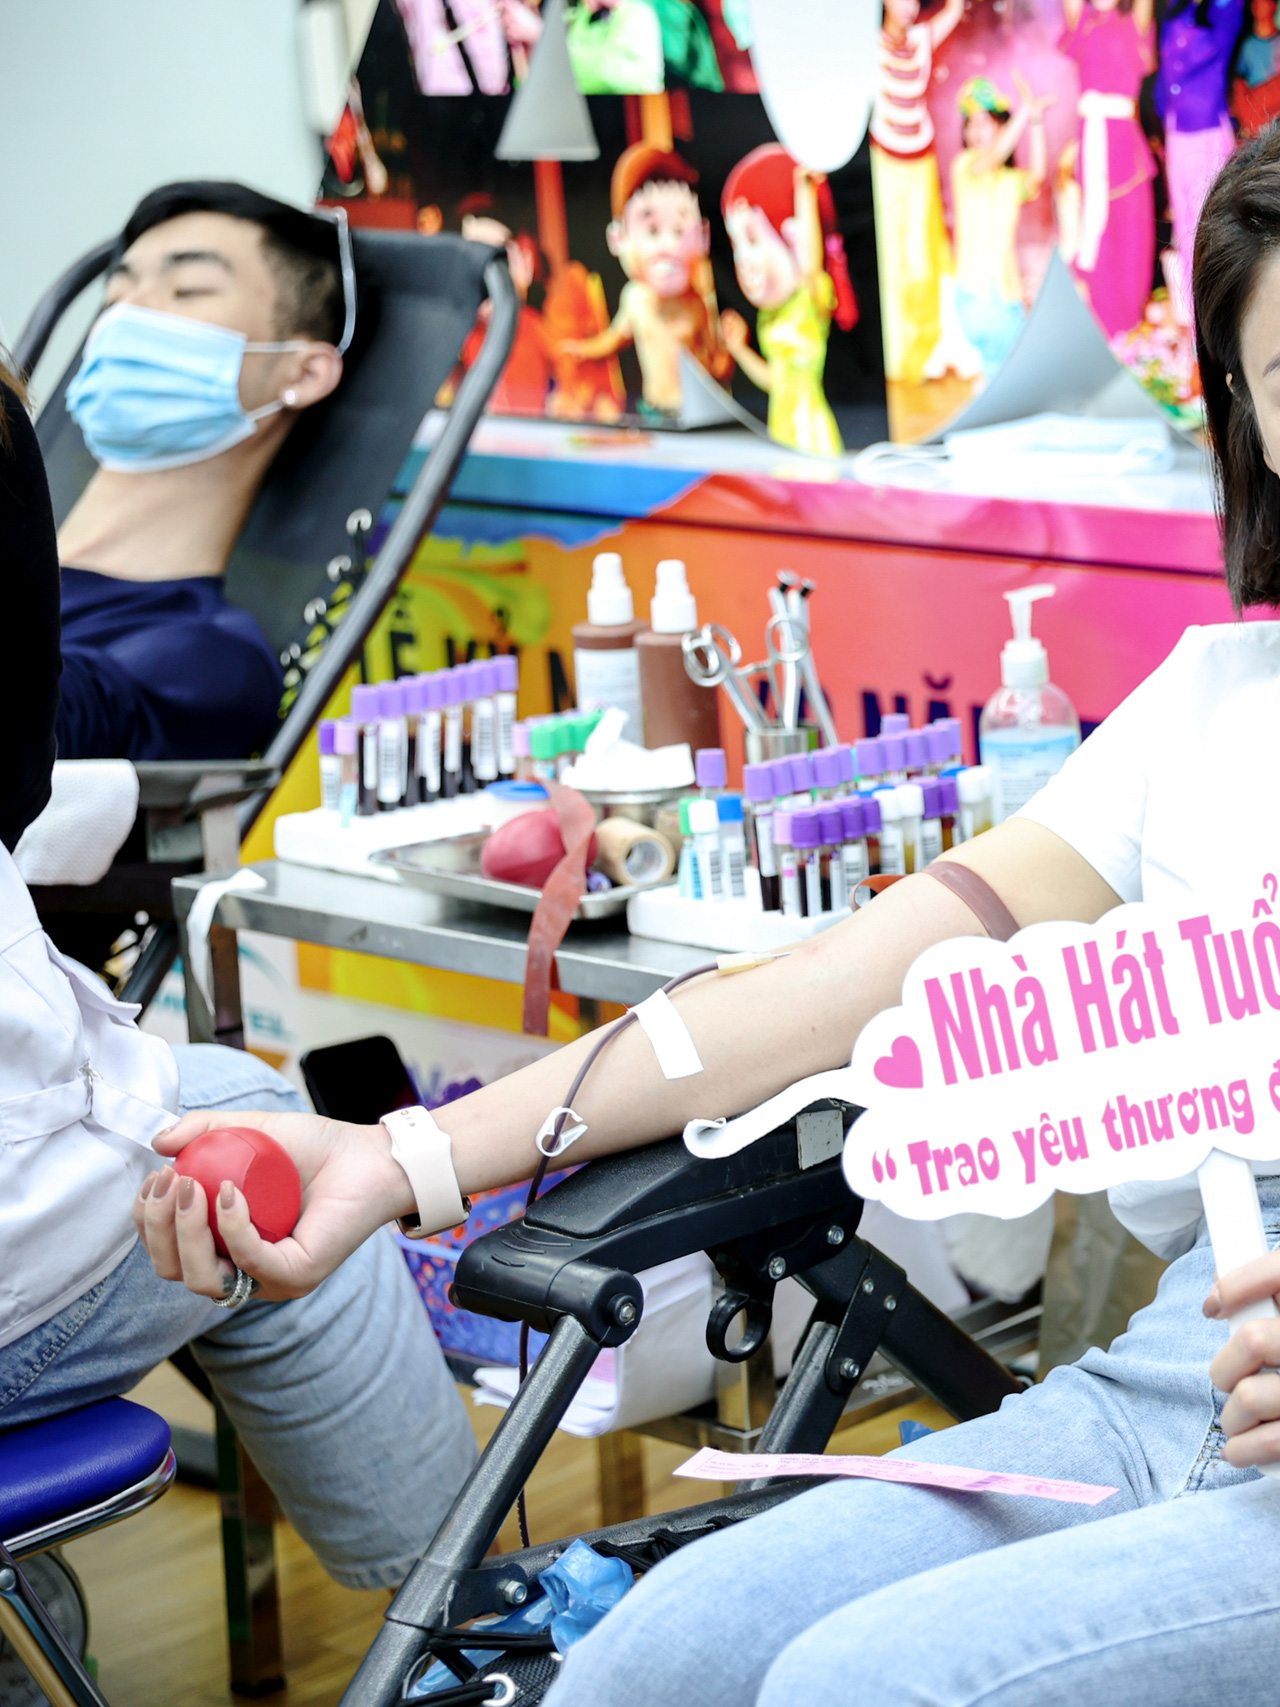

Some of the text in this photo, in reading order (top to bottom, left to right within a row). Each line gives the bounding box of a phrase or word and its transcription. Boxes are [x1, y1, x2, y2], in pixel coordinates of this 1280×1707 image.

[924, 954, 1059, 1086] Nhà
[1061, 929, 1180, 1054] Hát
[907, 1137, 1000, 1196] Trao
[1012, 1112, 1090, 1185] yêu
[1101, 1078, 1255, 1153] thương
